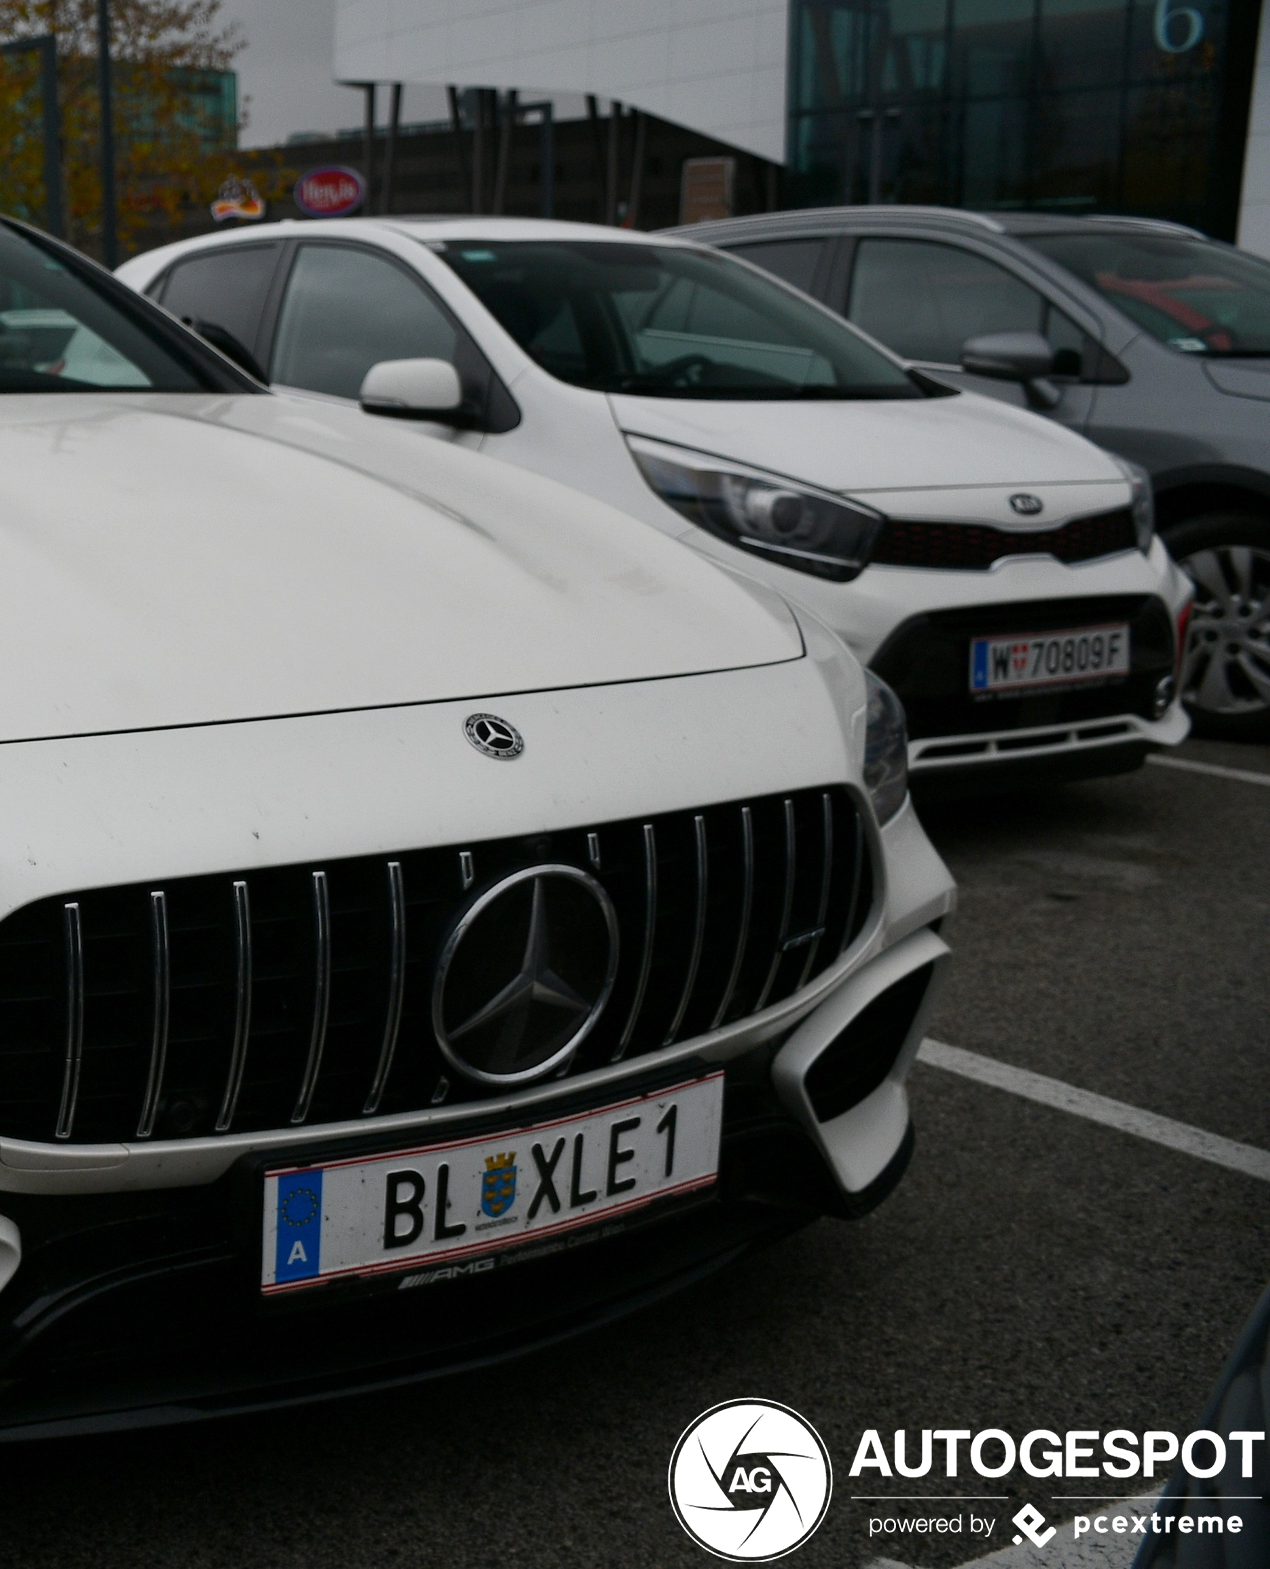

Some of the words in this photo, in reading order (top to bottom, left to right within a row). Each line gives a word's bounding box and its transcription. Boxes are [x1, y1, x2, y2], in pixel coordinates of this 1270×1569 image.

[1154, 0, 1205, 53] 6
[383, 1164, 467, 1250] BL
[287, 1240, 308, 1266] A
